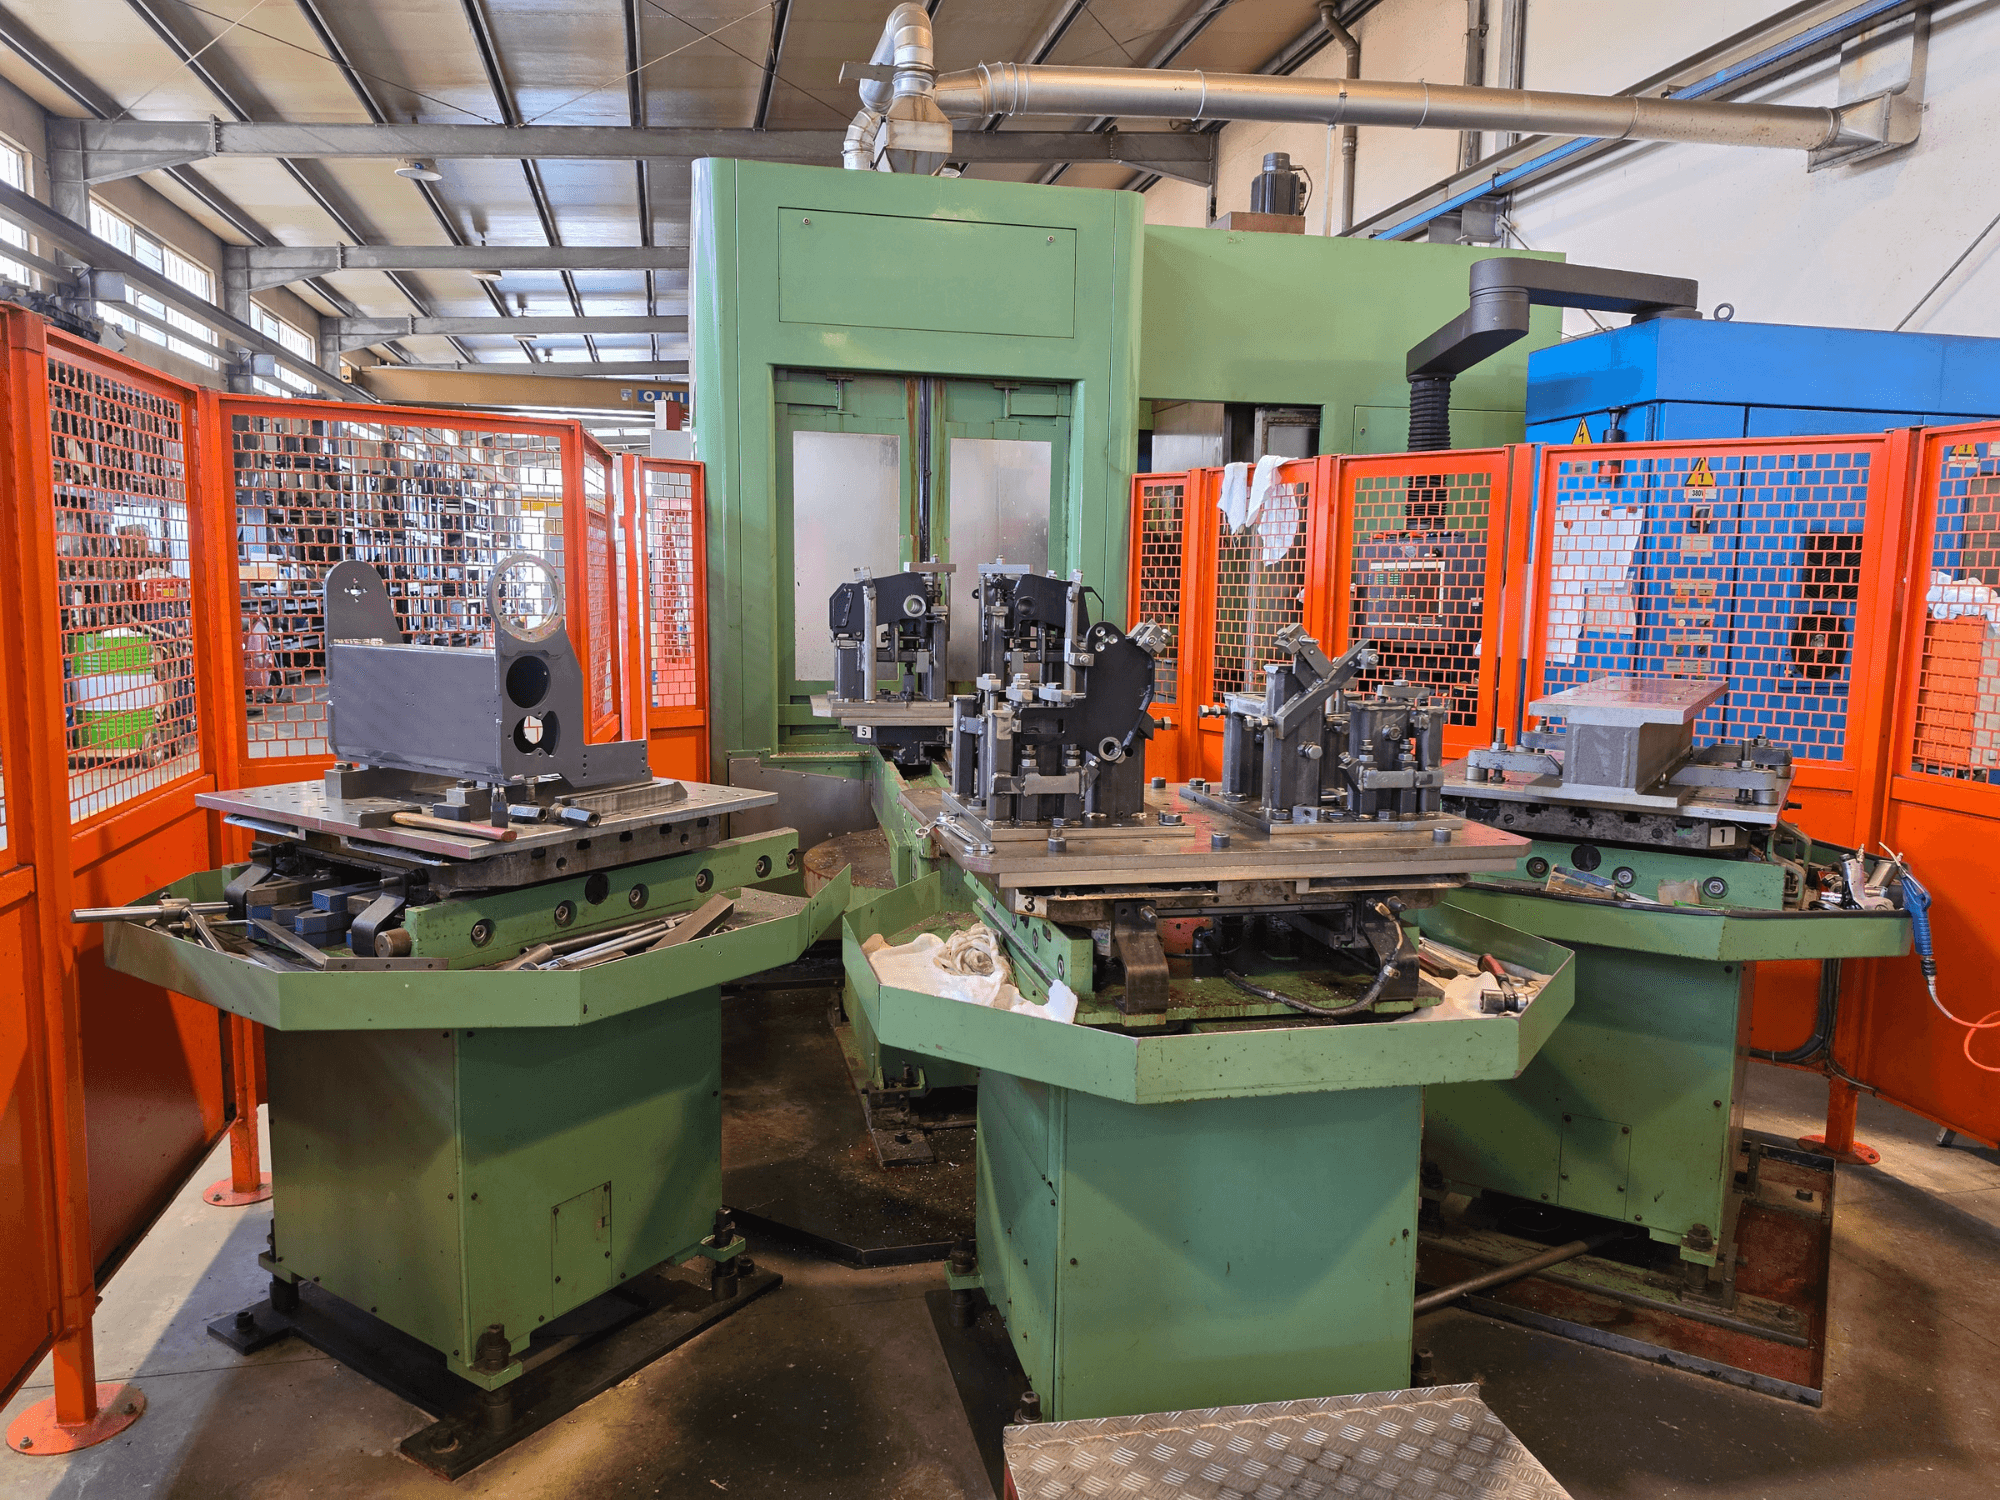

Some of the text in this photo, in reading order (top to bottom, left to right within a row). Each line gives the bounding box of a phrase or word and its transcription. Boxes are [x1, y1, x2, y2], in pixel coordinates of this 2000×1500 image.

[861, 727, 867, 737] 5
[1720, 829, 1726, 844] 1
[1024, 895, 1036, 913] 3
